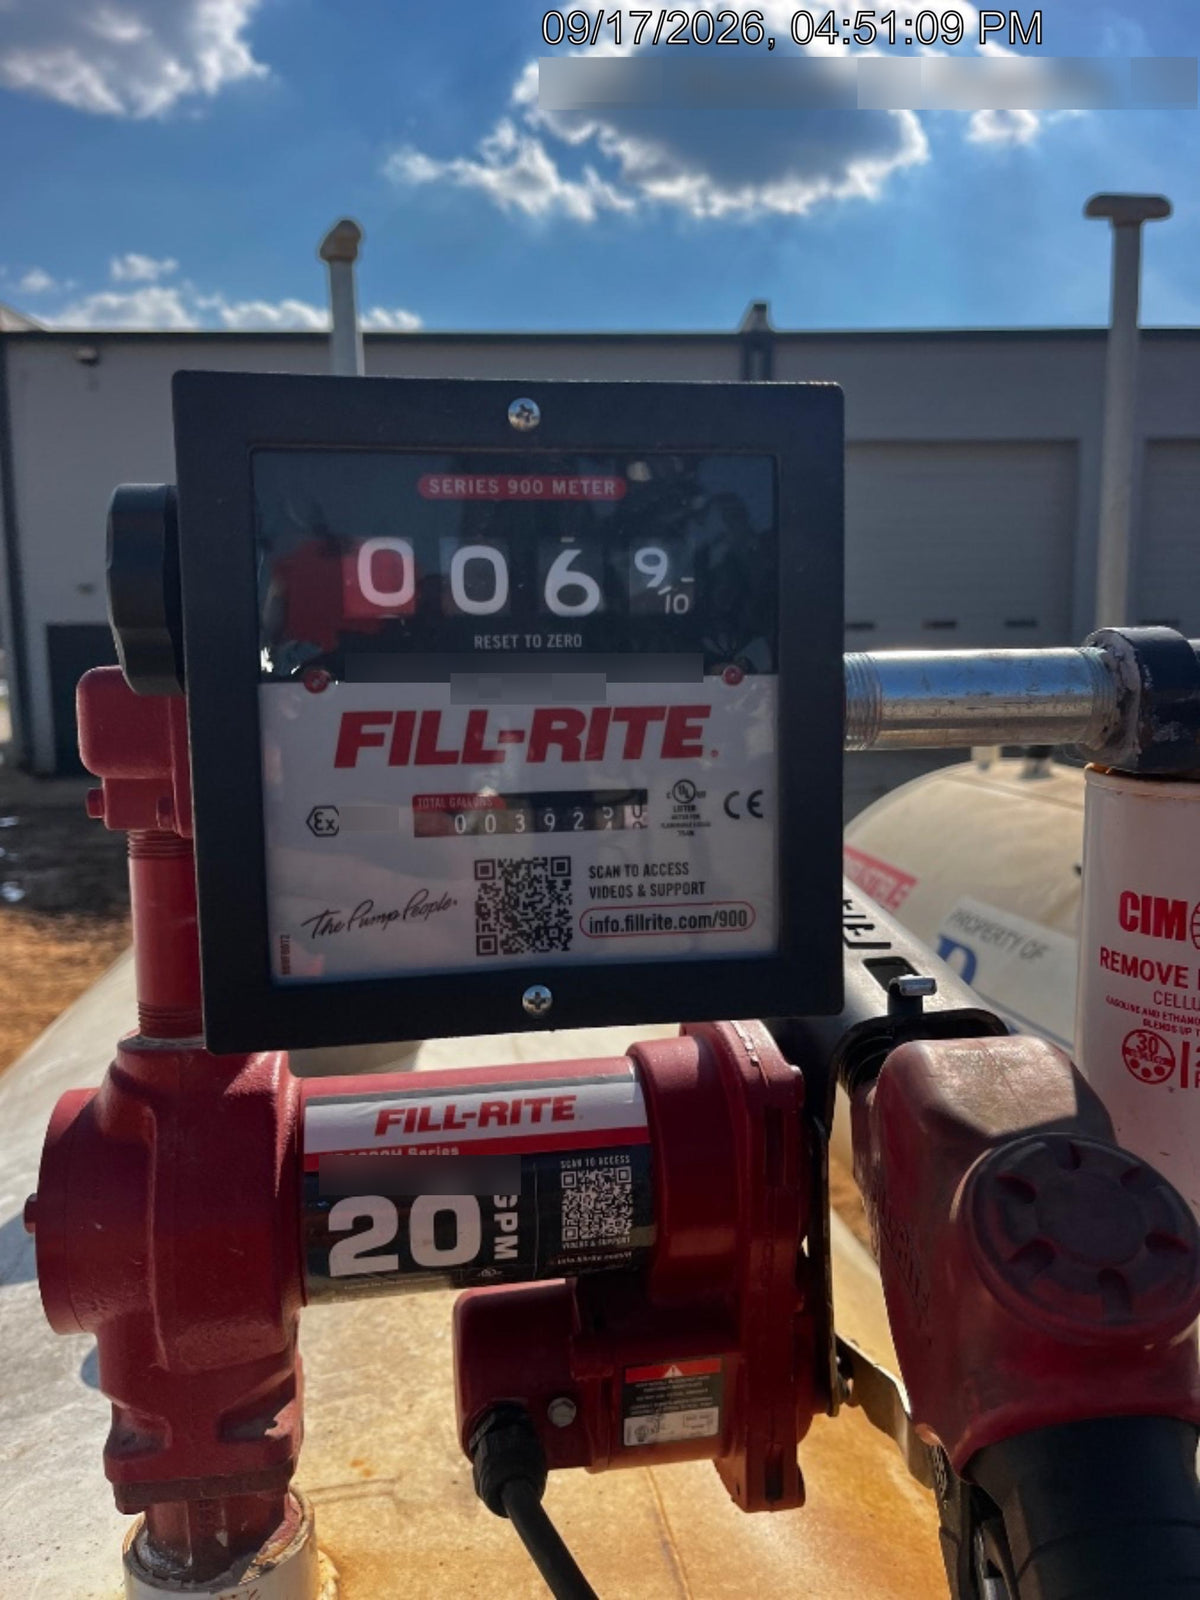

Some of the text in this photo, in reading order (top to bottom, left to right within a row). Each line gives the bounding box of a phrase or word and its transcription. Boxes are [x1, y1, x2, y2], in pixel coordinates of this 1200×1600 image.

[428, 478, 616, 495] SERIES 900 METER
[473, 633, 583, 650] RESET TO ZERO
[334, 704, 712, 768] FILL-RITE
[417, 797, 446, 809] TOTAL
[588, 861, 690, 880] SCAN TO ACCESS
[589, 881, 706, 900] VIDEOS & SUPPORT
[301, 908, 346, 940] The
[347, 899, 400, 931] Pump
[589, 909, 748, 935] info.fillrite.com/900
[1100, 945, 1189, 990] REMOVE
[1179, 1026, 1193, 1036] UP
[374, 1095, 577, 1137] FILL-RITE
[328, 1194, 482, 1278] 20
